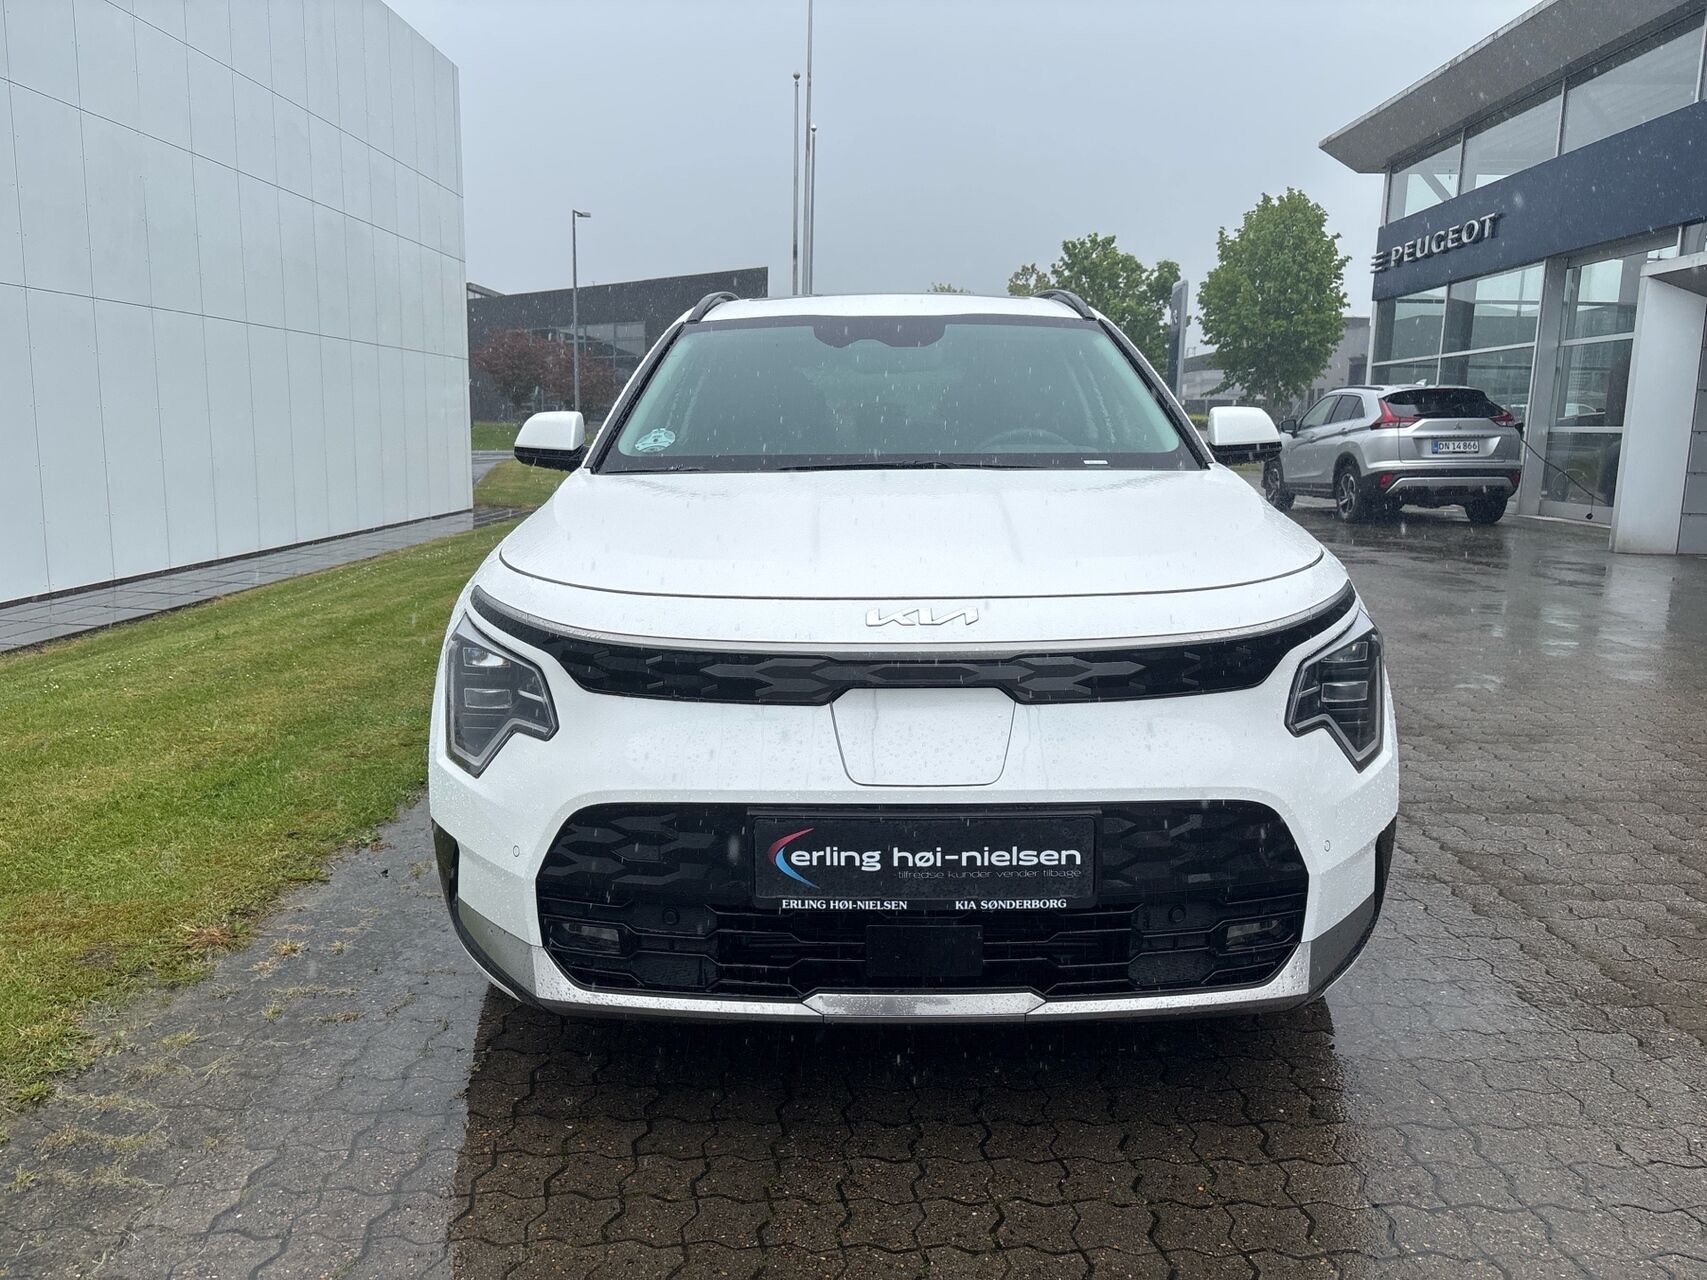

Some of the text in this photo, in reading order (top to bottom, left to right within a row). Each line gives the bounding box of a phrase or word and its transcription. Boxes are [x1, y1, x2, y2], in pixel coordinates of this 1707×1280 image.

[1390, 212, 1497, 267] PEUGEOT
[1452, 442, 1462, 450] 14
[1463, 441, 1478, 450] 866
[790, 846, 1081, 871] erling høi-nielsen
[898, 868, 1082, 879] tilfredse kunder vender tilbage
[782, 899, 908, 910] ERLING HØI-NIELSEN
[955, 899, 1067, 910] KIA SØNDERBORG
